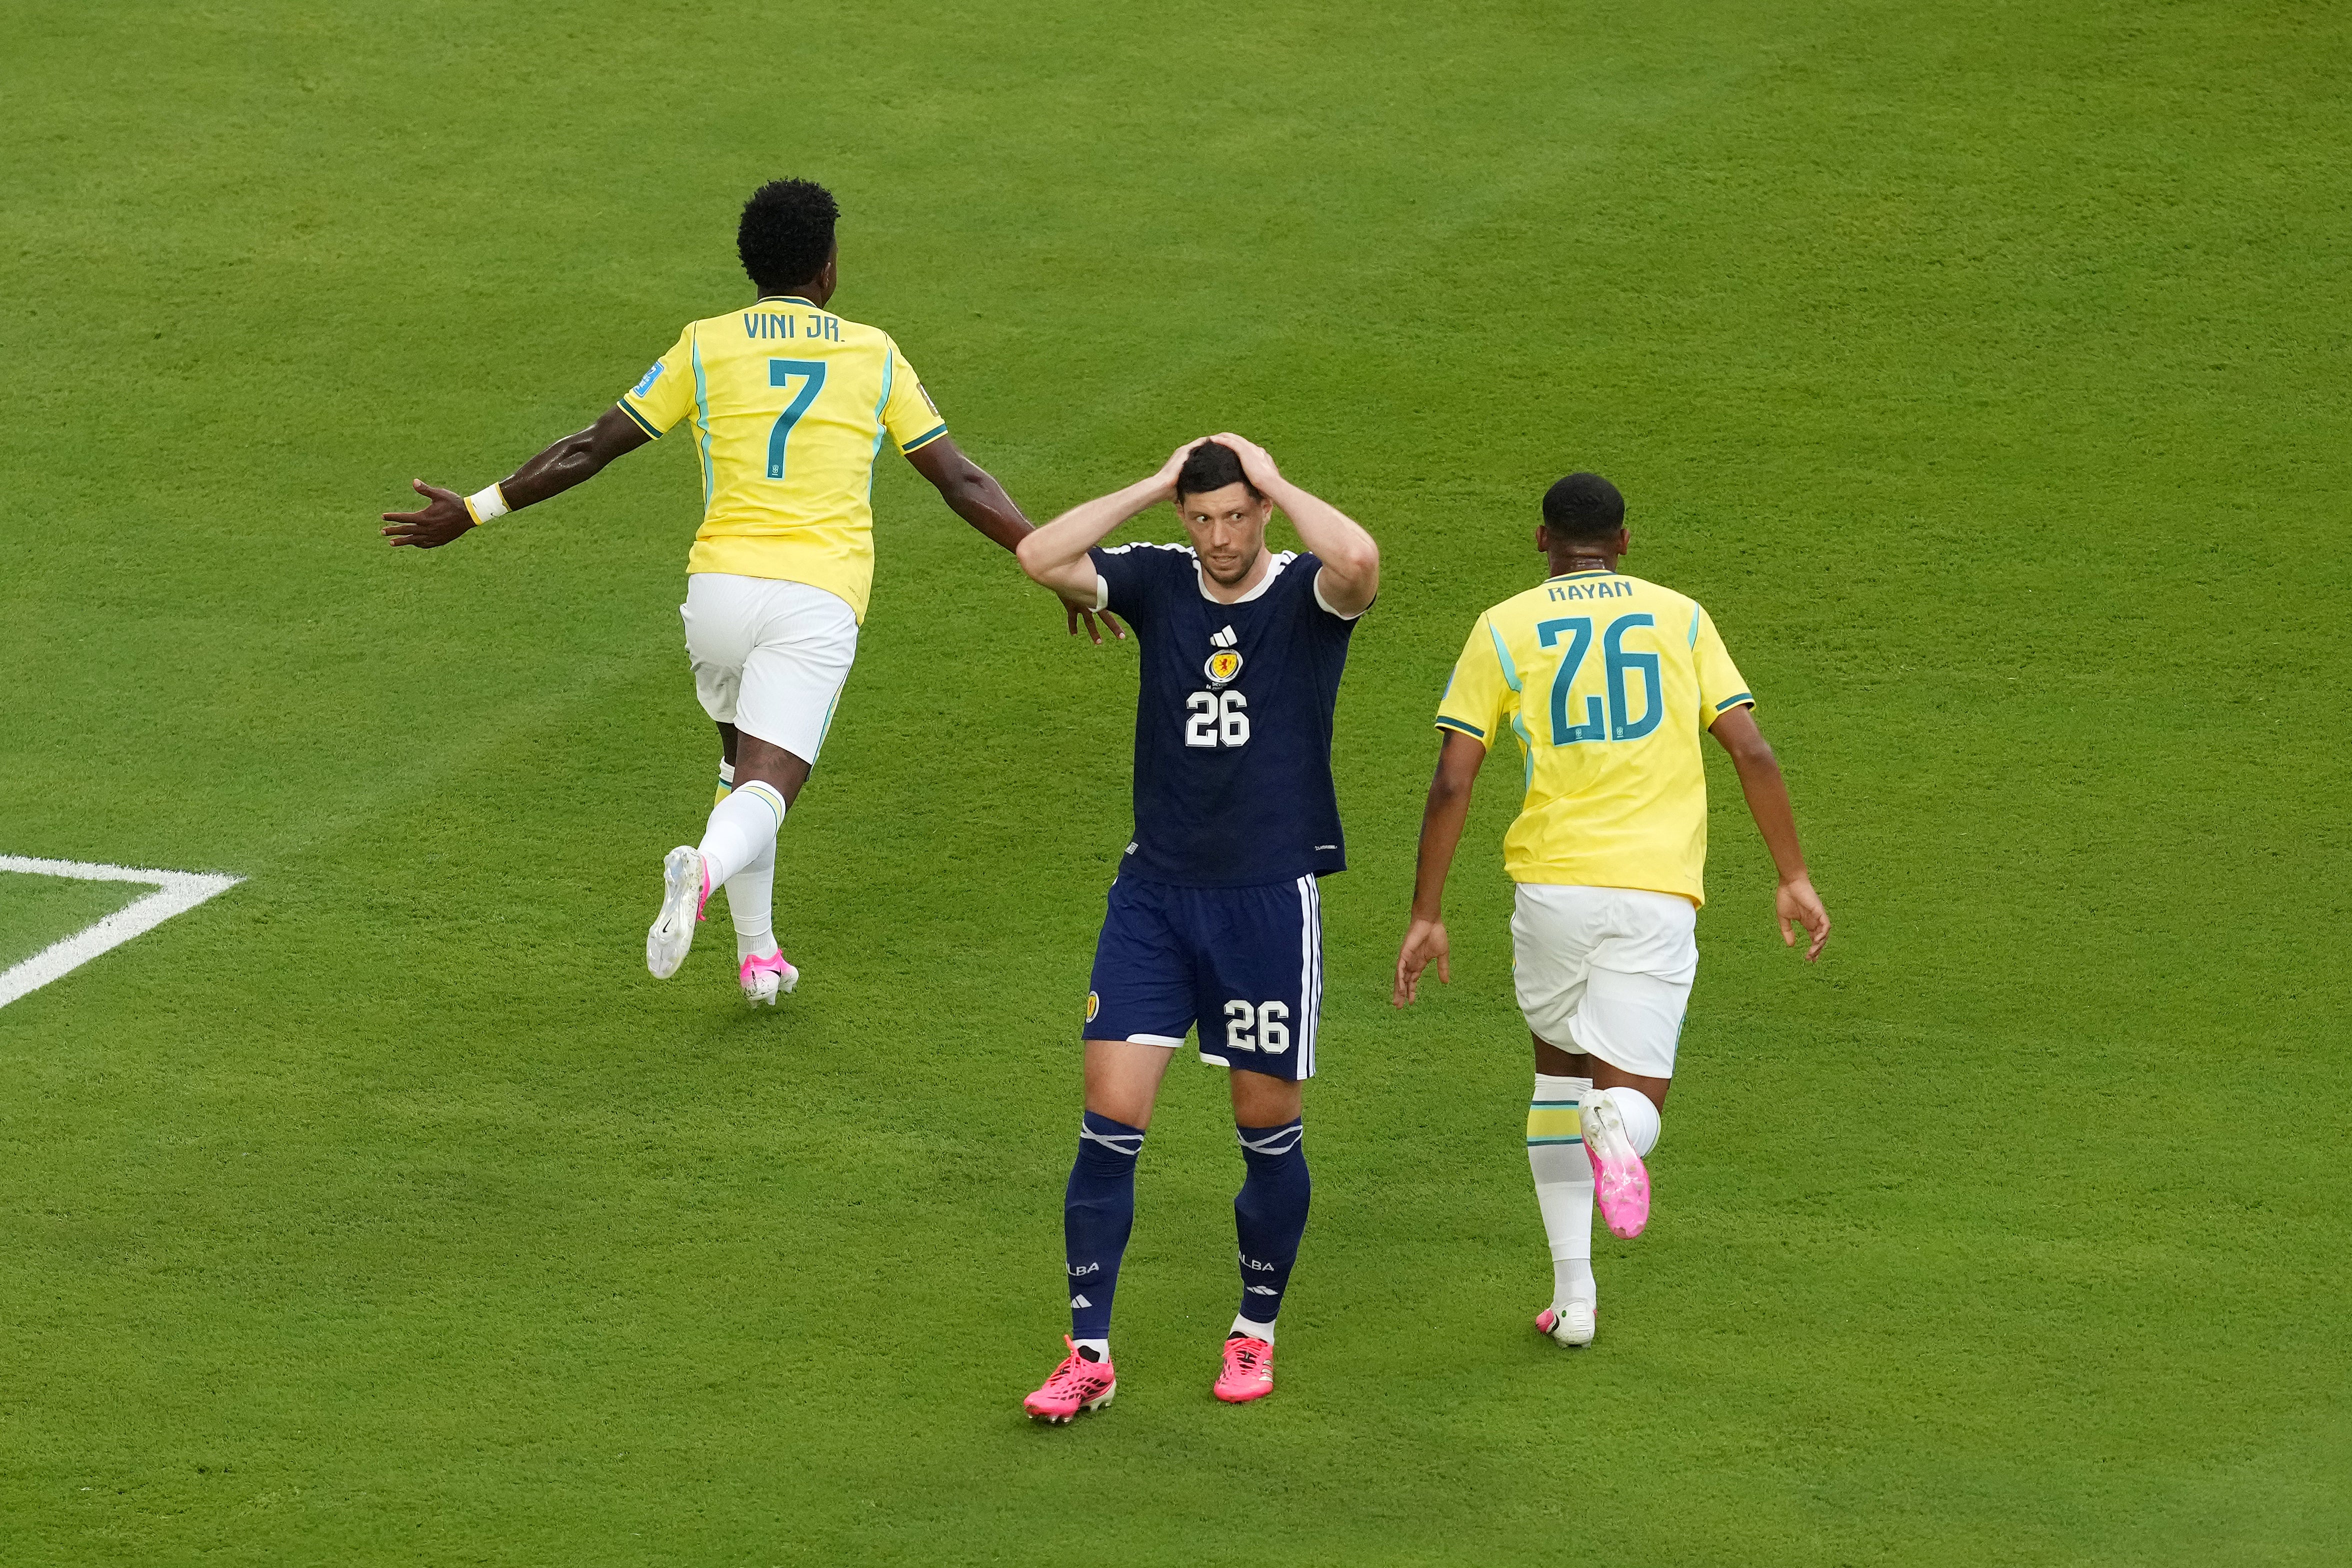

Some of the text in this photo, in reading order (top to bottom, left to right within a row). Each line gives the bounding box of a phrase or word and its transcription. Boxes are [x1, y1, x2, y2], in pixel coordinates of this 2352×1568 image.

[744, 313, 846, 342] VINI JR.
[766, 358, 828, 479] 7
[1548, 581, 1633, 602] RAYAN
[1536, 614, 1664, 746] 26
[1185, 690, 1250, 747] 26
[1224, 1000, 1290, 1054] 26
[1066, 1260, 1100, 1276] LBA
